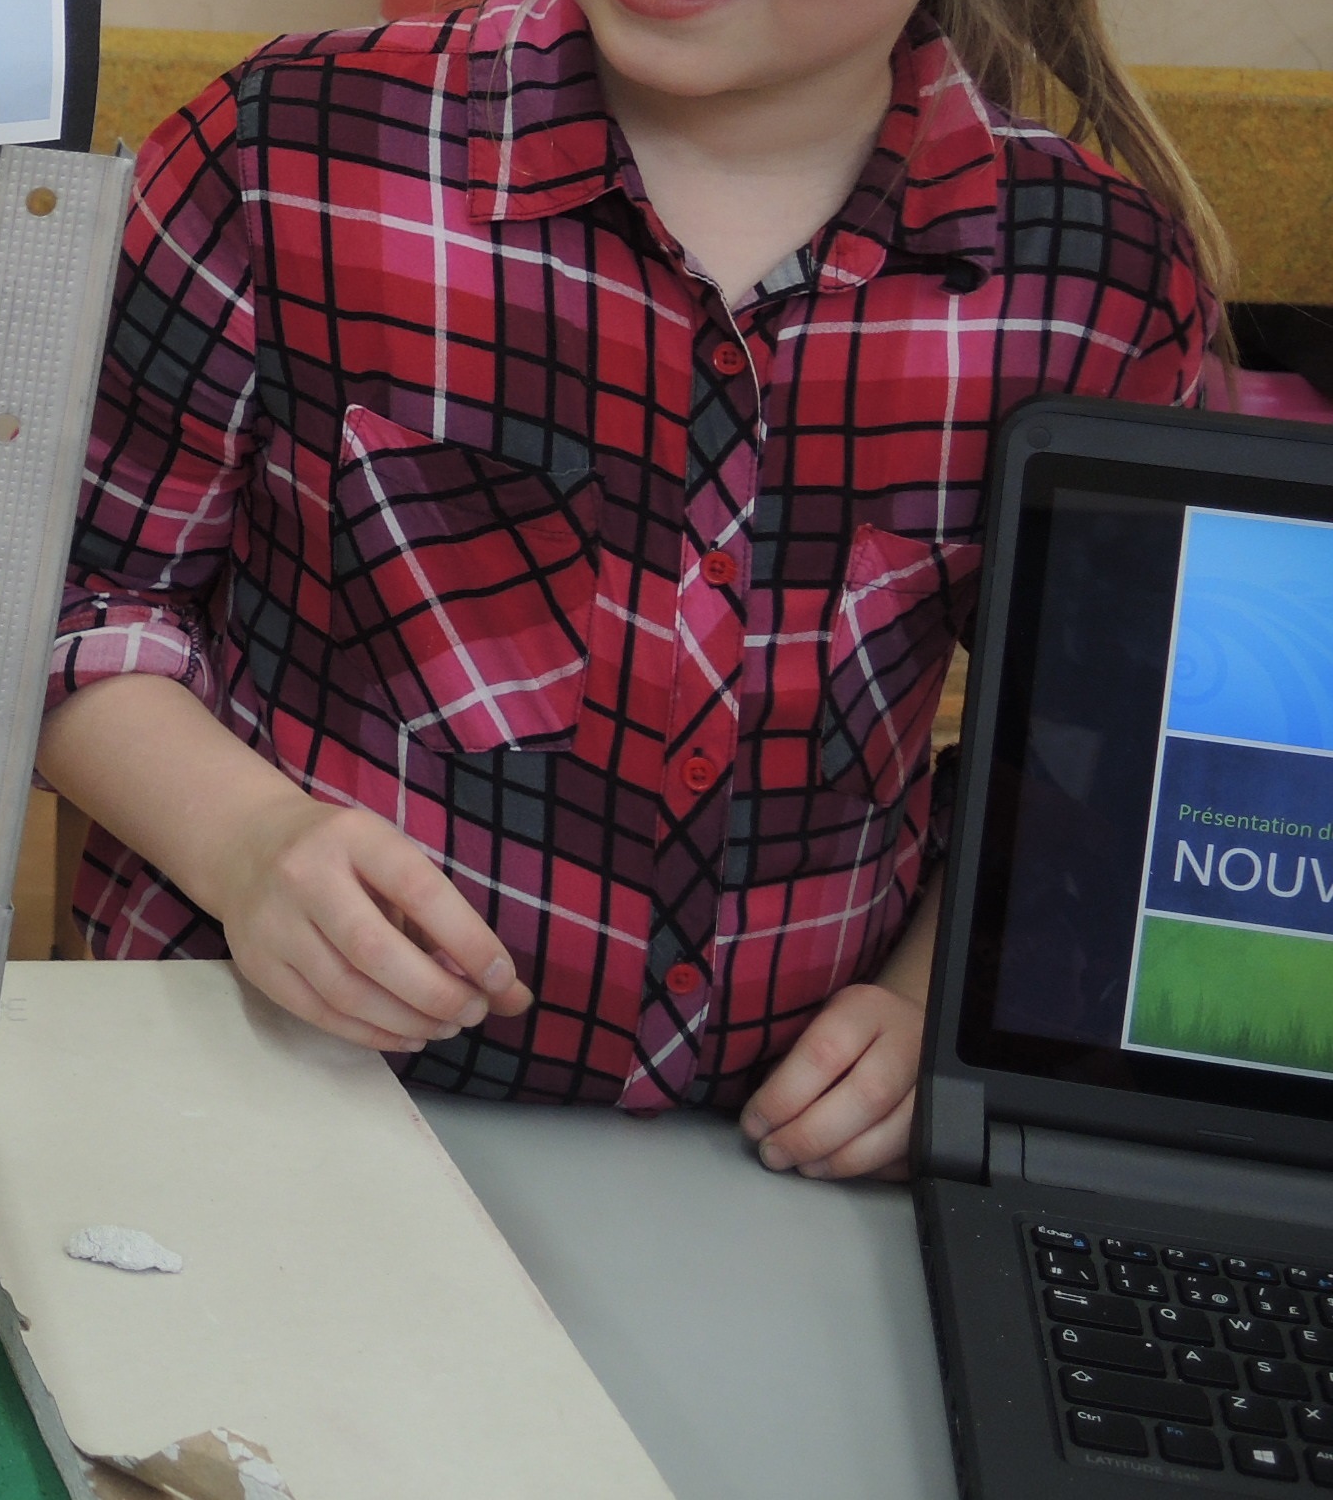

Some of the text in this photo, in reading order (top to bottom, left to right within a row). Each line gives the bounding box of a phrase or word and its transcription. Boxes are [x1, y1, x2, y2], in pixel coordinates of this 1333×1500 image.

[1179, 804, 1333, 840] Présentation d
[1173, 839, 1333, 903] NOUV
[1107, 1238, 1121, 1247] F1
[1168, 1249, 1184, 1258] F2
[1230, 1258, 1246, 1268] F3
[1291, 1267, 1307, 1277] F4
[1190, 1290, 1202, 1300] 2
[1259, 1301, 1272, 1311] 3
[1160, 1308, 1178, 1321] Q
[1228, 1318, 1251, 1331] W
[1303, 1330, 1318, 1342] E
[1186, 1350, 1202, 1362] A
[1257, 1361, 1272, 1373] S
[1231, 1396, 1248, 1409] Z
[1077, 1411, 1102, 1423] Ctrl
[1304, 1407, 1321, 1420] X
[1166, 1426, 1184, 1436] Fn
[1086, 1454, 1163, 1476] LATITUDE
